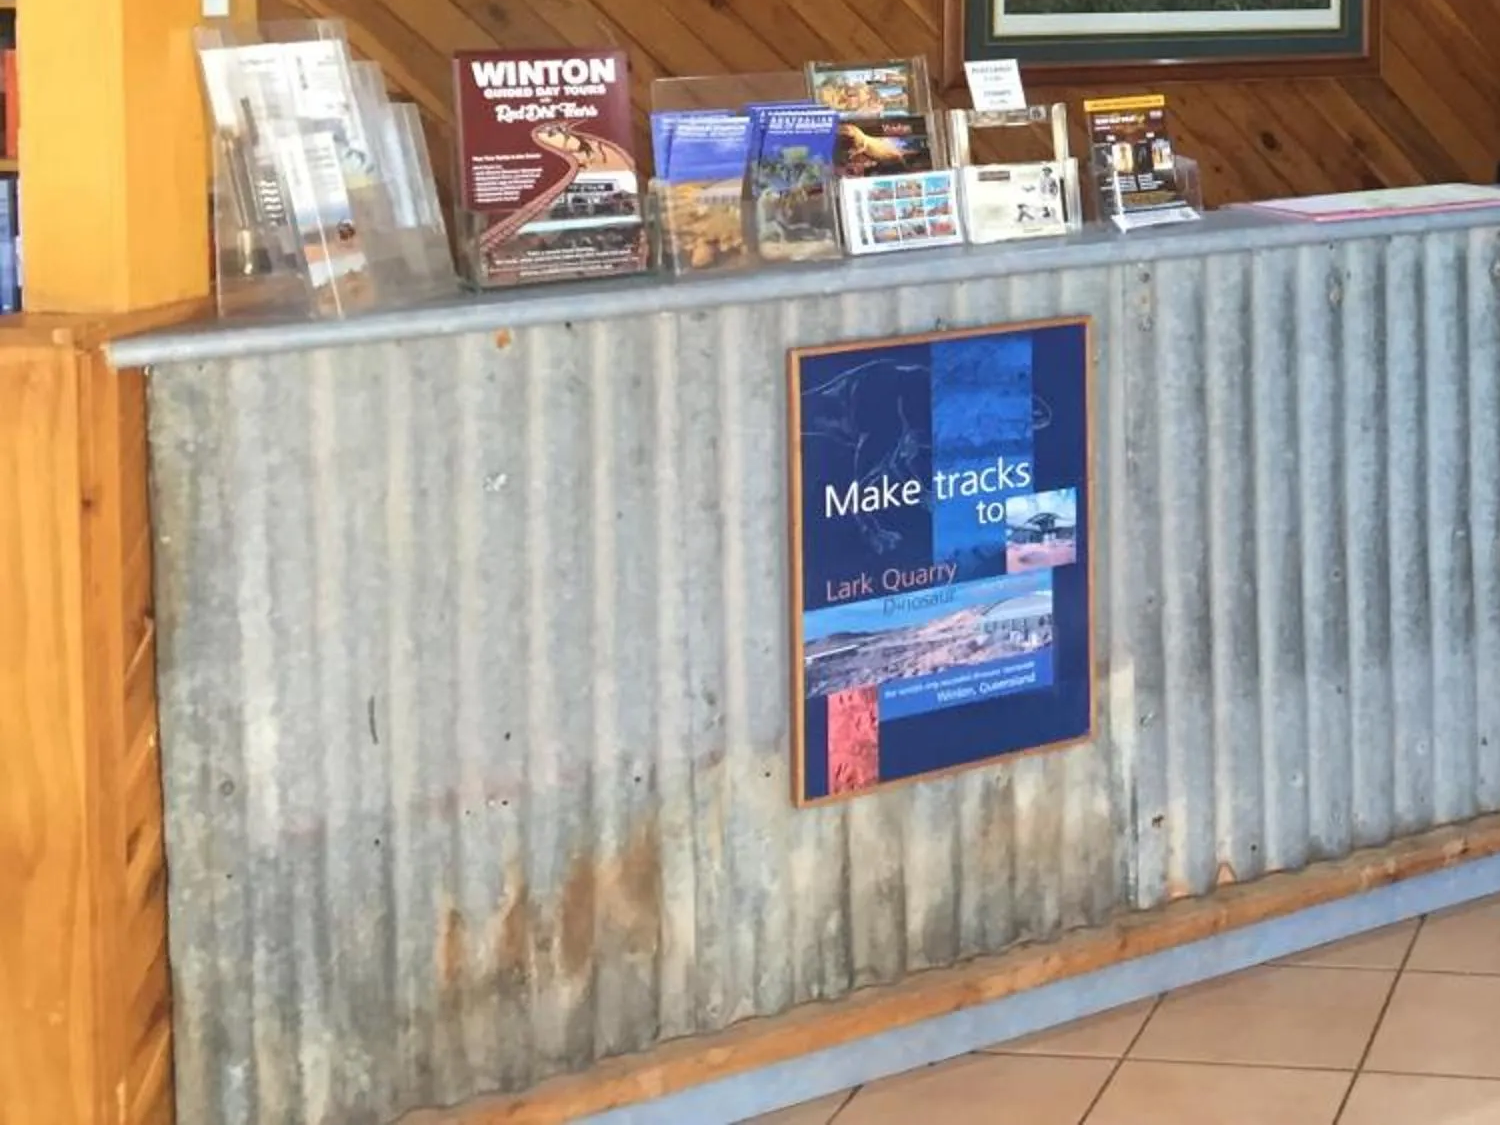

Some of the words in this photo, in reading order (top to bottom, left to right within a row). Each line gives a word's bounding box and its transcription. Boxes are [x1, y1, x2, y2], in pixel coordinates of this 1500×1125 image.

[472, 58, 616, 88] WINTON
[536, 86, 560, 97] DAY
[563, 84, 606, 96] TOURS
[825, 475, 921, 518] Make
[933, 457, 1031, 500] tracks
[976, 500, 1006, 524] to
[826, 572, 873, 602] Lark
[883, 562, 957, 591] Quarry
